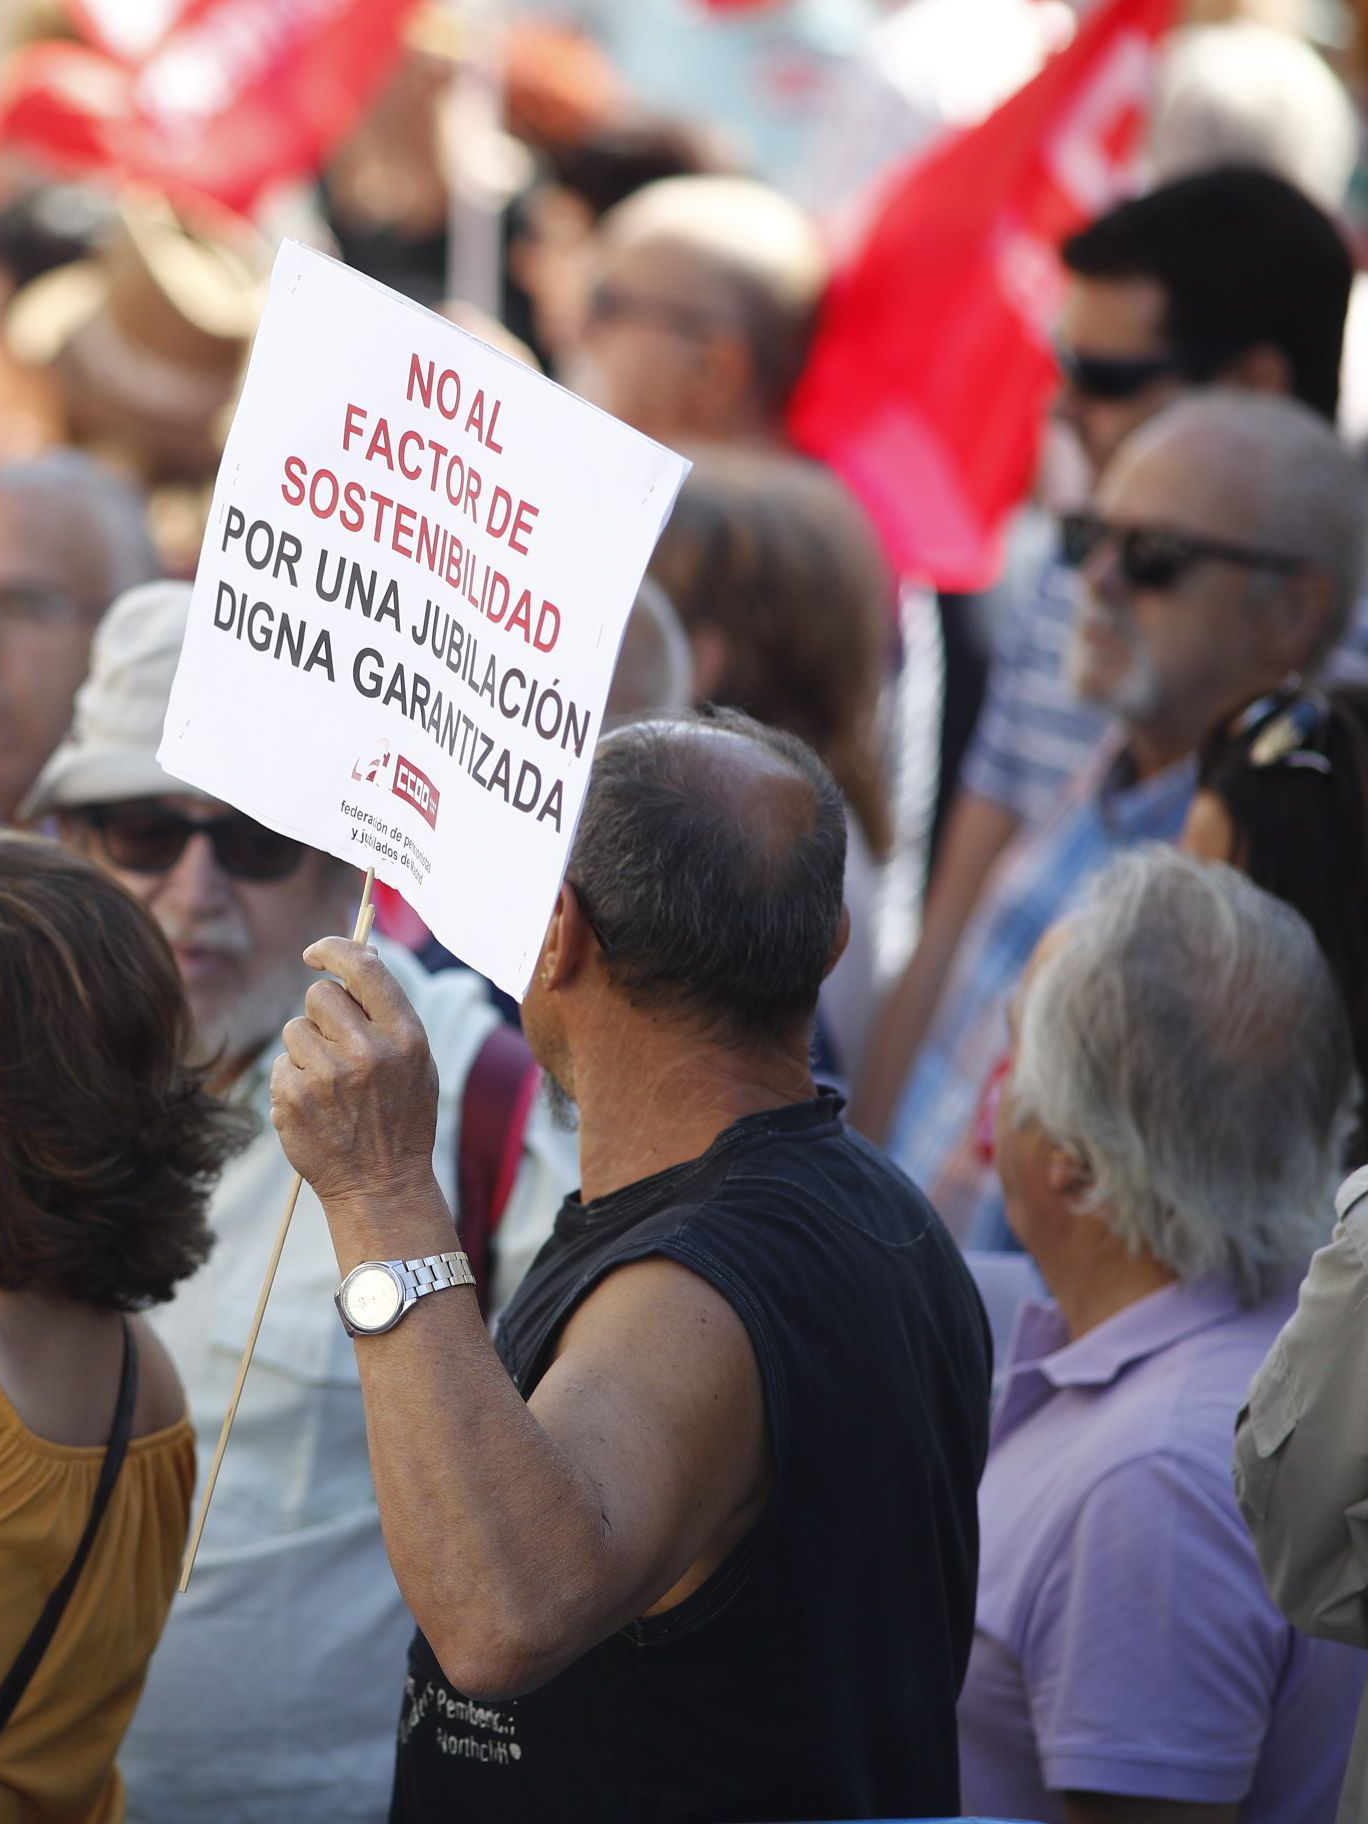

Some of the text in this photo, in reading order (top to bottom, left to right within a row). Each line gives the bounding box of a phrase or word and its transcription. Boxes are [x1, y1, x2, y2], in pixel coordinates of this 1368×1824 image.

[406, 353, 503, 455] NO AL
[342, 403, 540, 556] FACTOR DE
[281, 455, 562, 654] SOSTENIBILIDAD
[221, 505, 591, 759] POR UNA JUBILACIÓN
[213, 580, 565, 834] DIGNA GARANTIZADA
[350, 827, 359, 841] y
[400, 853, 411, 868] de
[389, 827, 403, 842] de
[396, 763, 431, 812] CCOO
